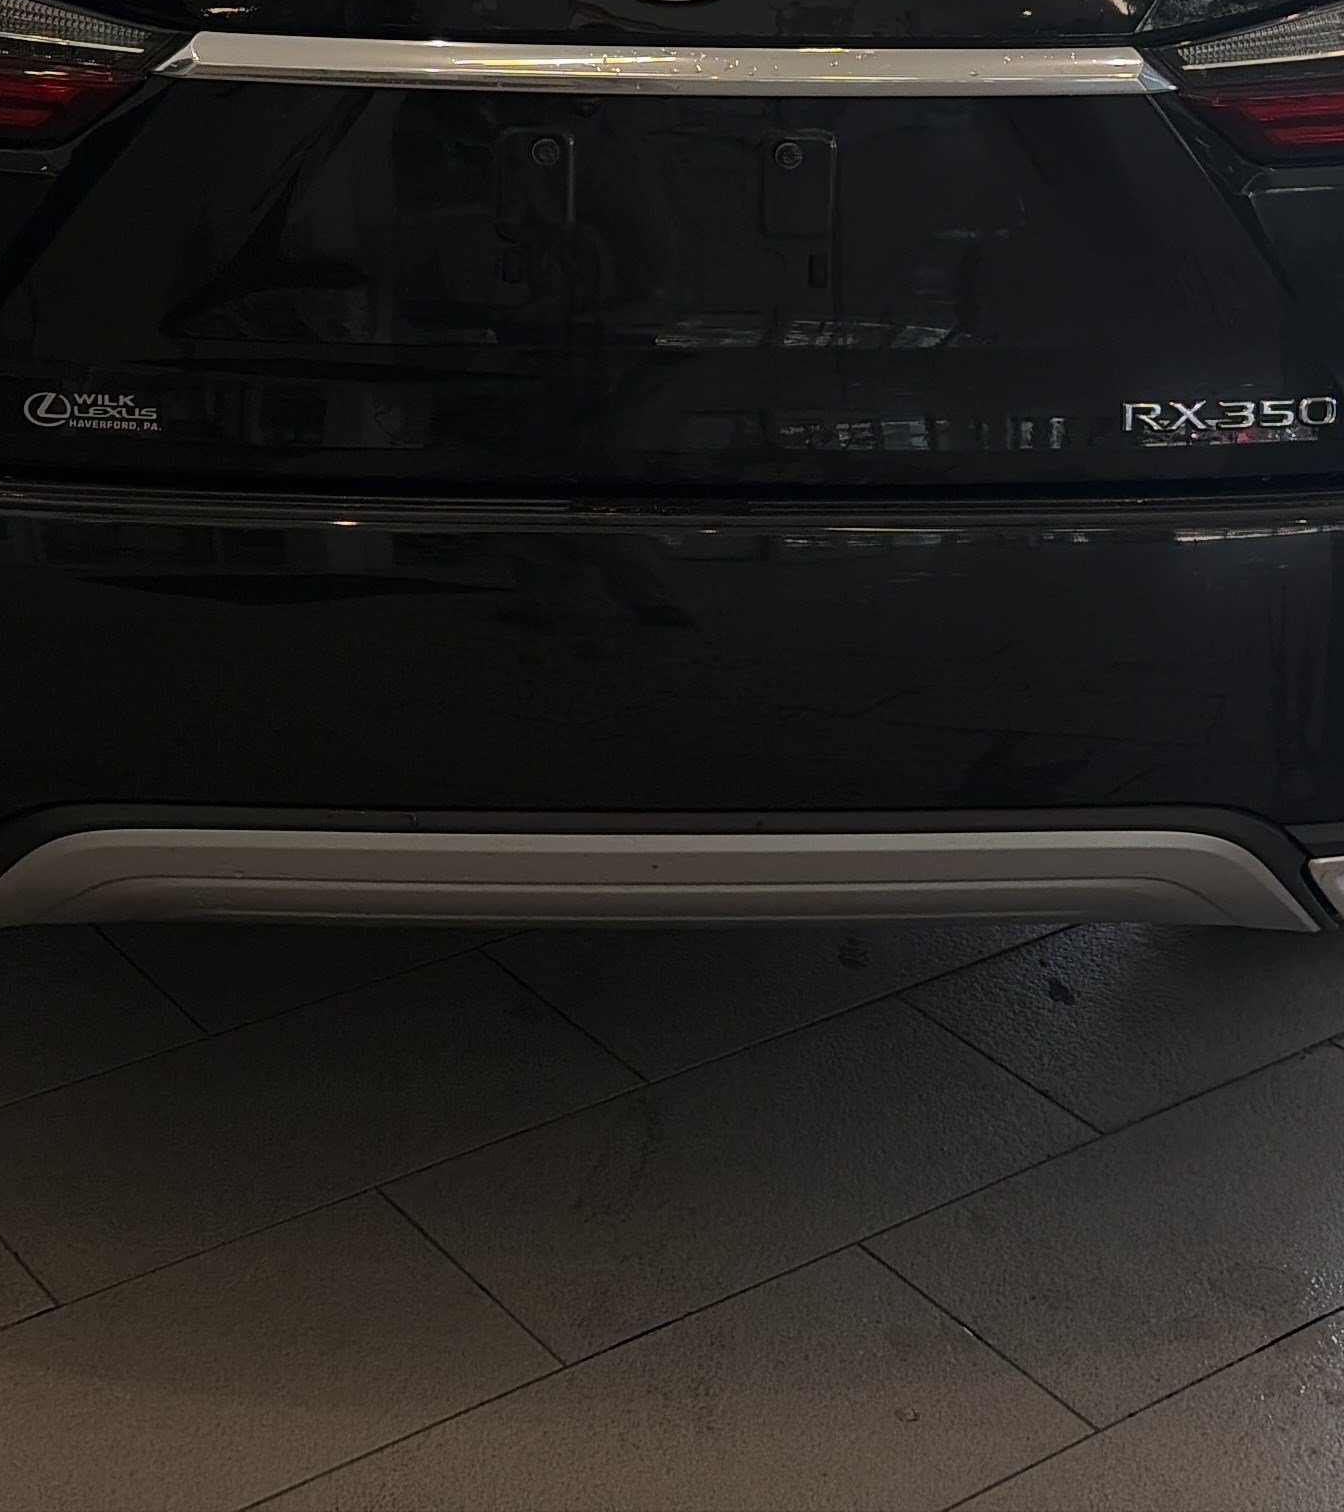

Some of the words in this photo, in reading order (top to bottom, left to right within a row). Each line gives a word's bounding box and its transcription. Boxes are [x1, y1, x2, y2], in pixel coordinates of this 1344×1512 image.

[73, 393, 136, 407] WILK
[74, 406, 158, 420] LEXUS
[69, 419, 141, 432] HAVERFORD,
[143, 421, 163, 432] PA.
